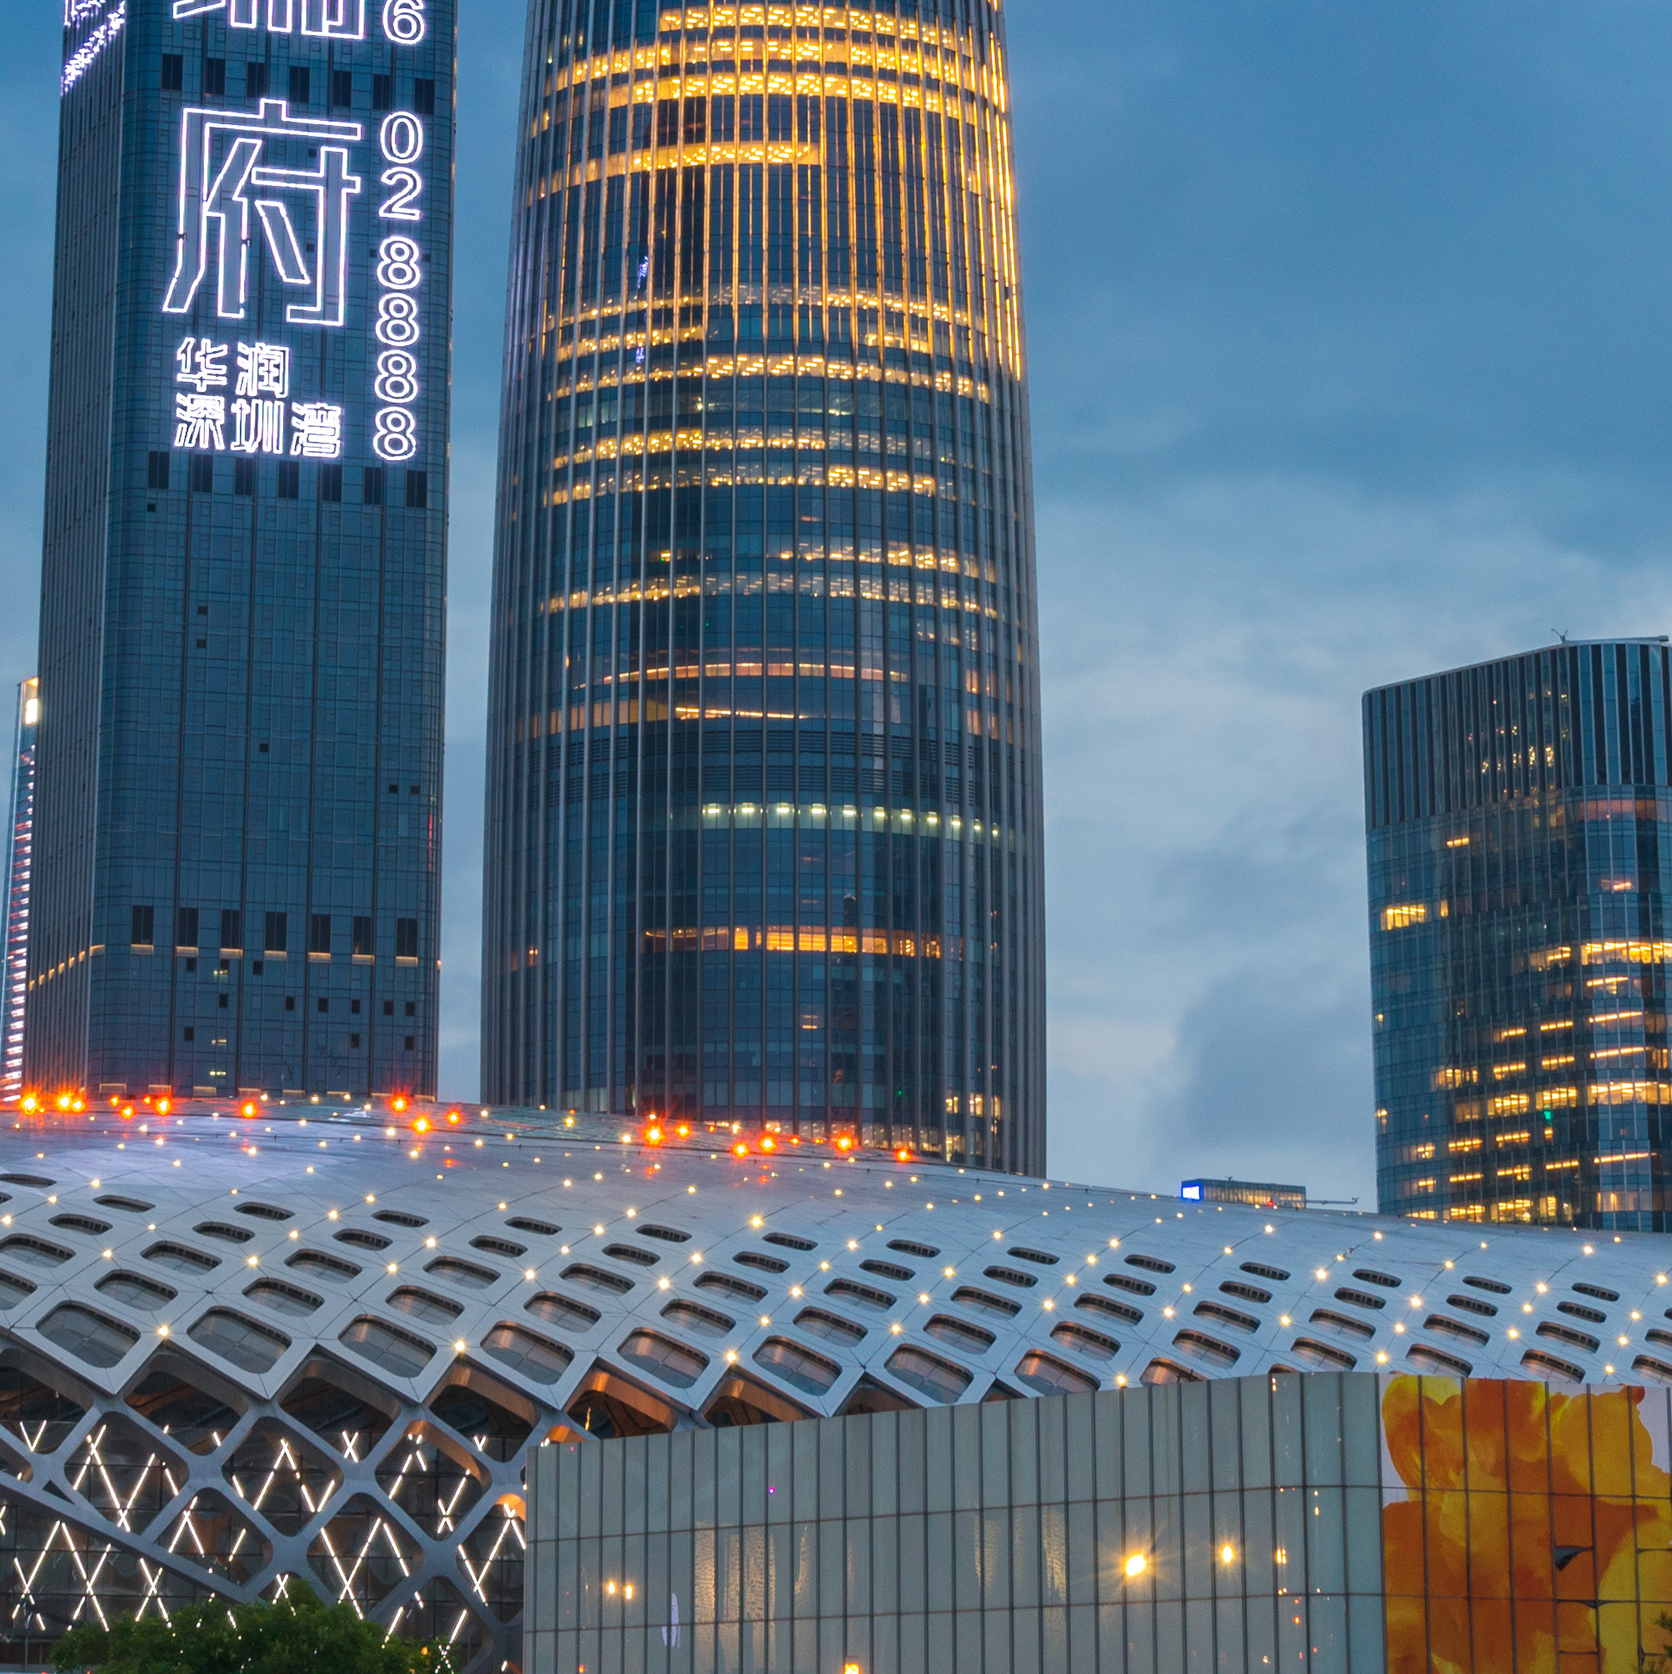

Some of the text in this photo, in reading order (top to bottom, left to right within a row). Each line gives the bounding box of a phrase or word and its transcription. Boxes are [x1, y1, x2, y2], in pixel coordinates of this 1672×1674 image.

[176, 336, 291, 399] 华润
[174, 392, 343, 459] 深圳湾
